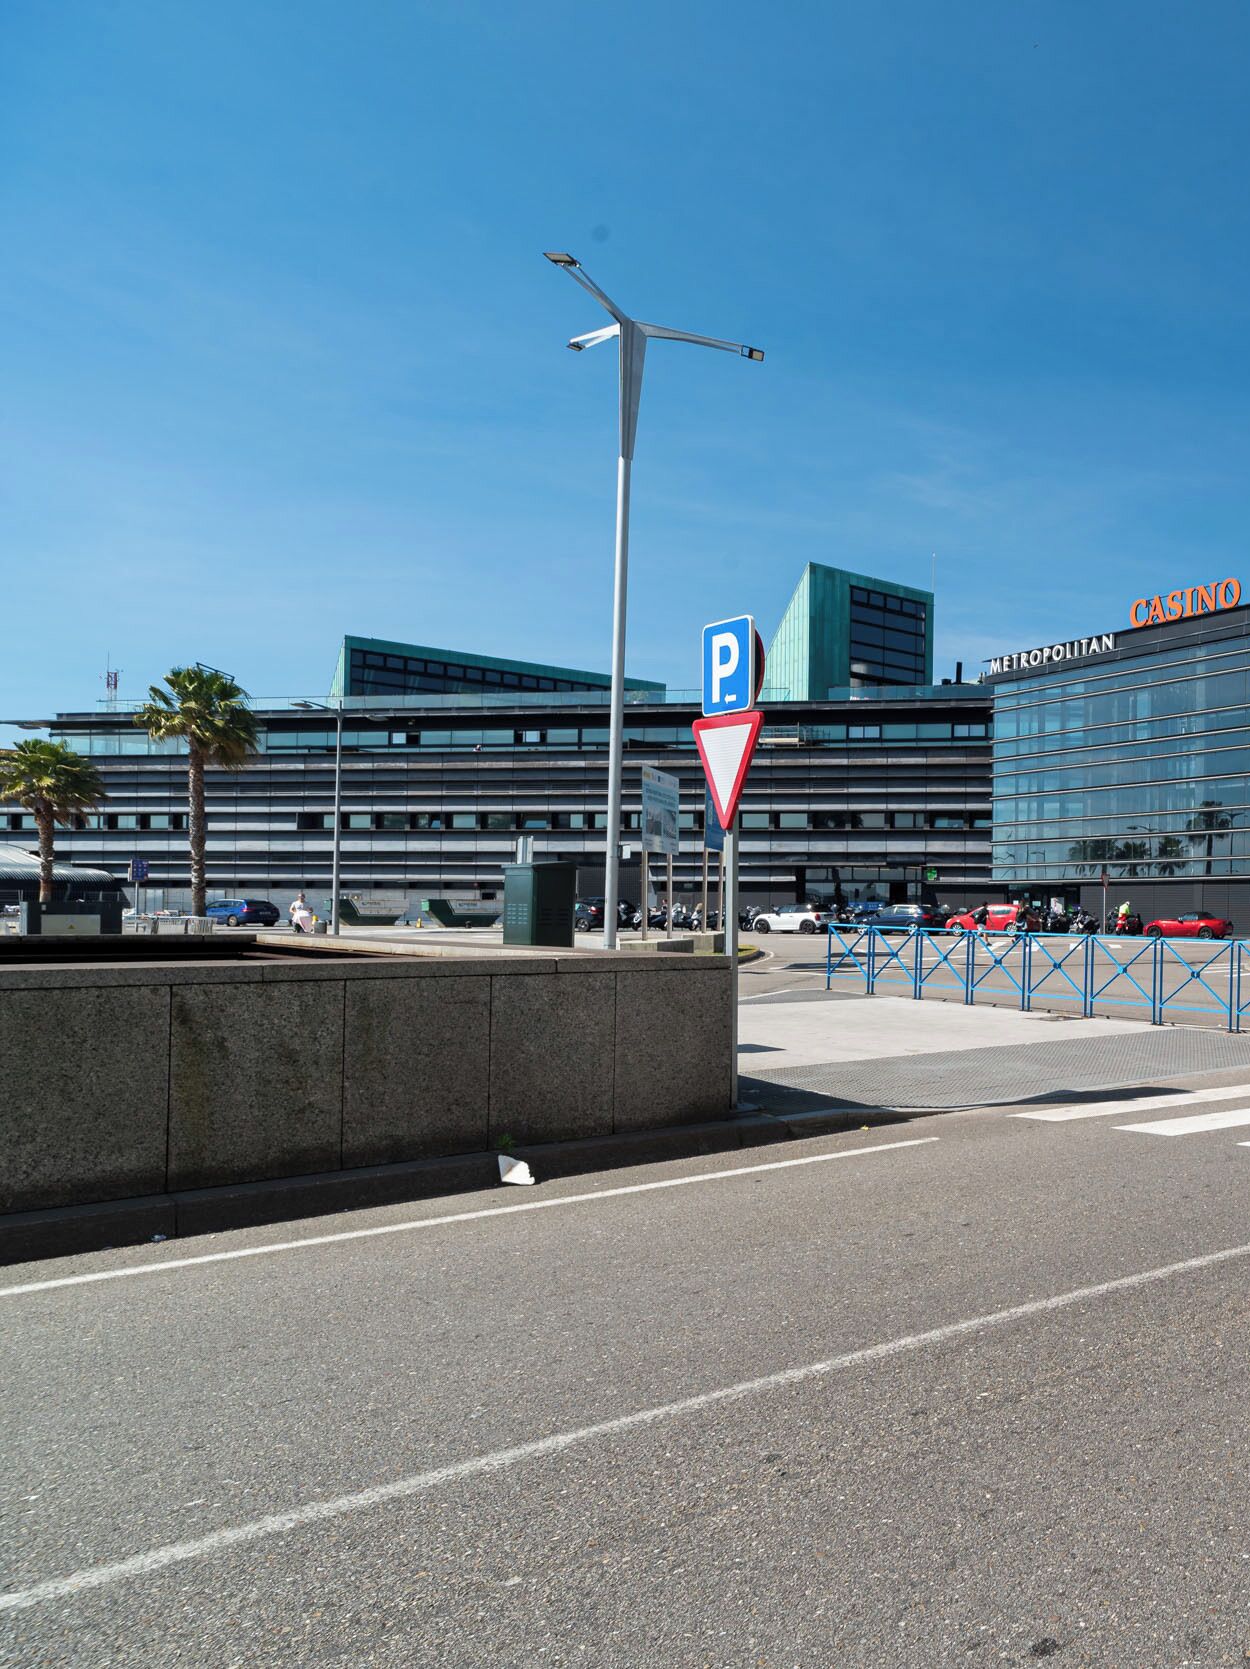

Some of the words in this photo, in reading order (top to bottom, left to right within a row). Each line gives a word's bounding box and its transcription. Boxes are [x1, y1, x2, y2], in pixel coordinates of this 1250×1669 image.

[1129, 577, 1242, 629] CASINO
[711, 631, 740, 704] P
[989, 633, 1115, 675] METROPOLITAN
